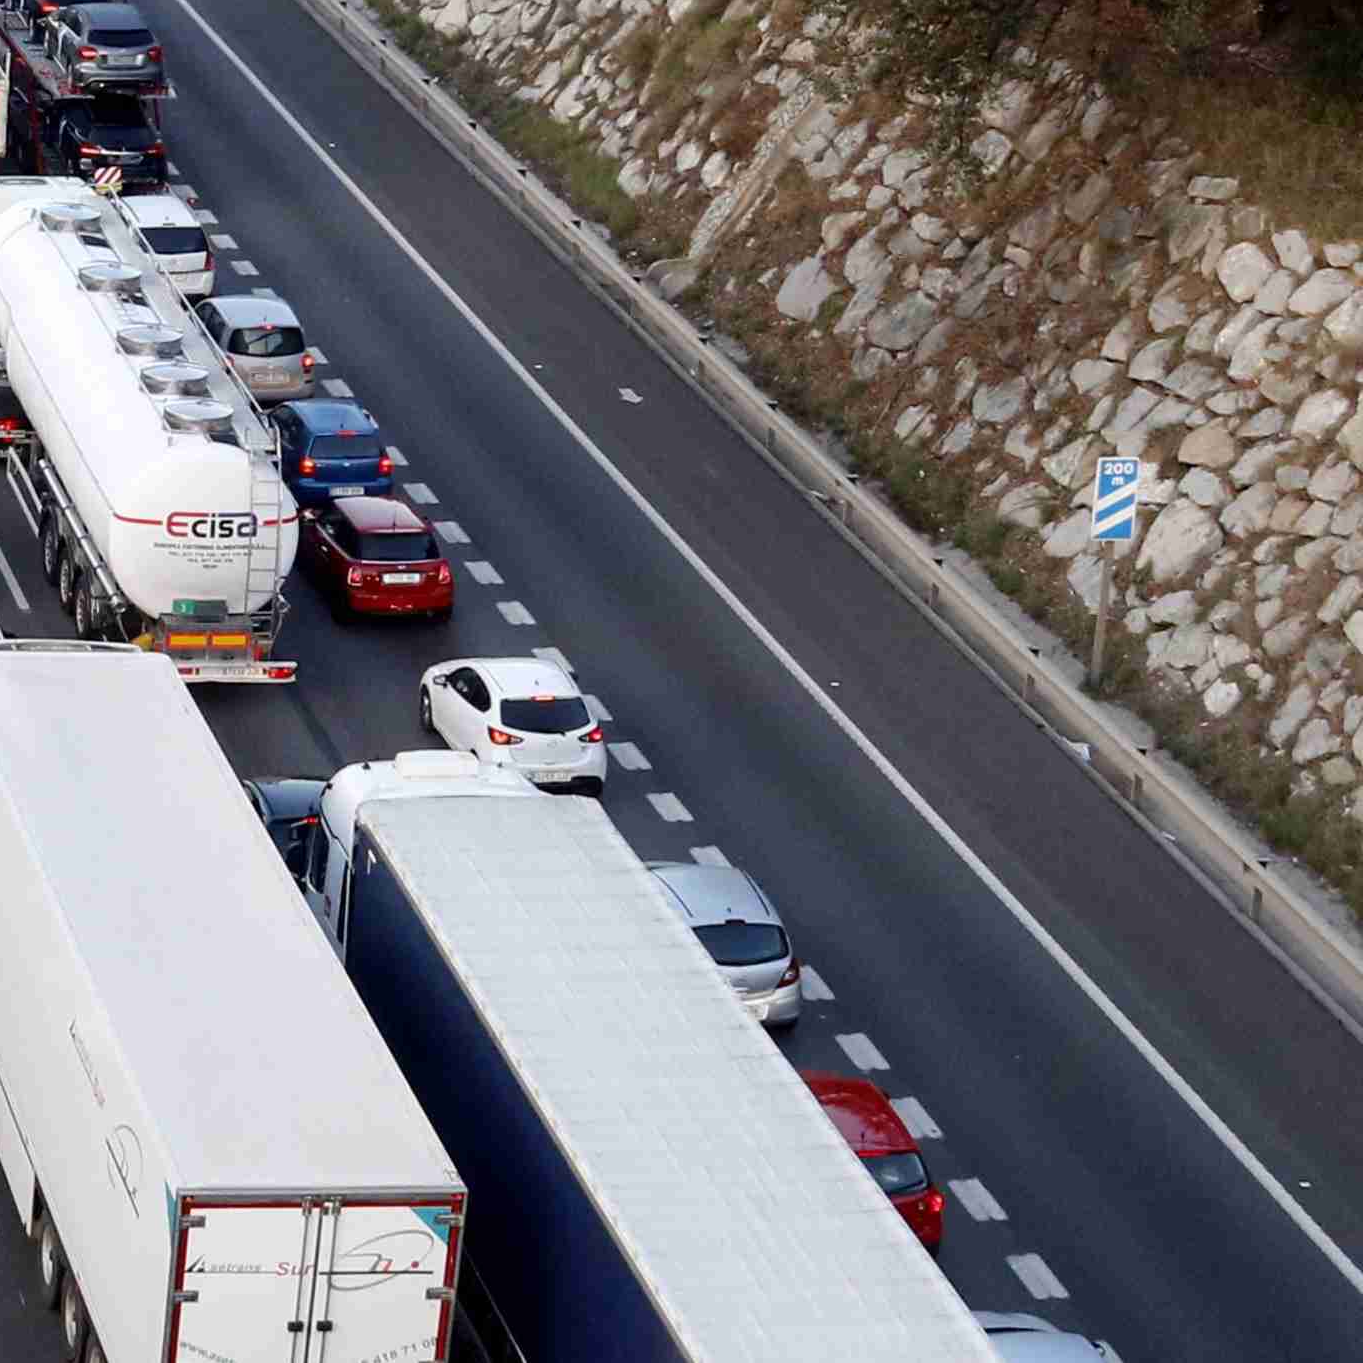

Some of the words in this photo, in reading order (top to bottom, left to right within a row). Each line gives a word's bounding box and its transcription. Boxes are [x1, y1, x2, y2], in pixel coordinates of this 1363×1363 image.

[1103, 461, 1135, 475] 200
[166, 511, 257, 539] Ecisa
[276, 1261, 315, 1276] Sur
